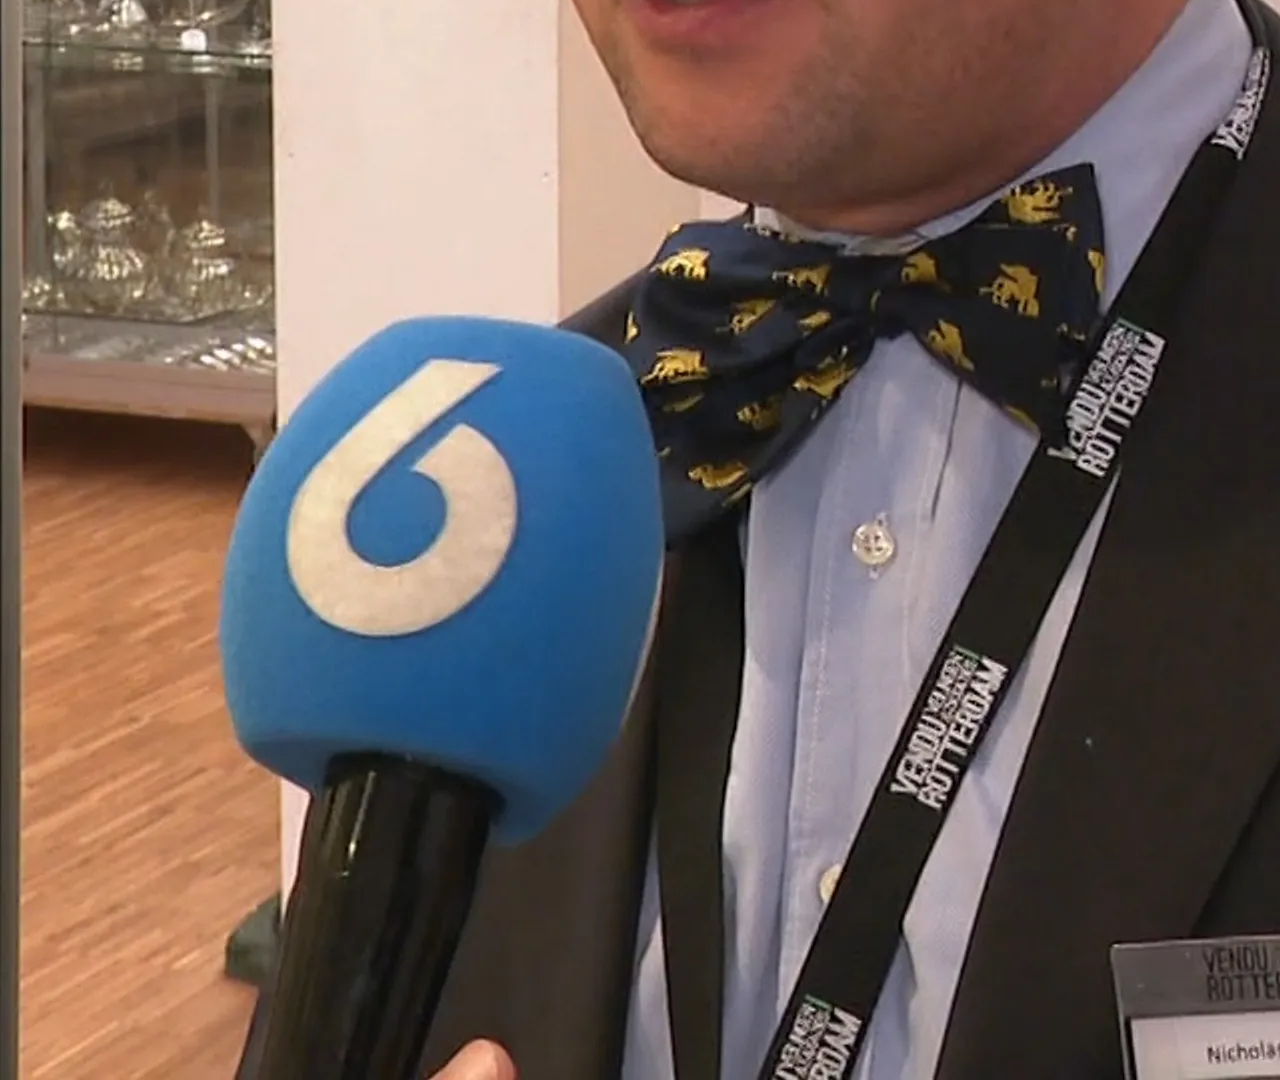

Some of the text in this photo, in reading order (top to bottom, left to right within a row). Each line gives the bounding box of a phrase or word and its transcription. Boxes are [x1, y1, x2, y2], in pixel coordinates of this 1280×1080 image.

[1076, 331, 1166, 478] ROTTERDAM
[286, 358, 518, 638] 6
[890, 715, 947, 795] VENDU
[917, 656, 1009, 809] ROTTERDAM
[1202, 945, 1268, 973] VENDU
